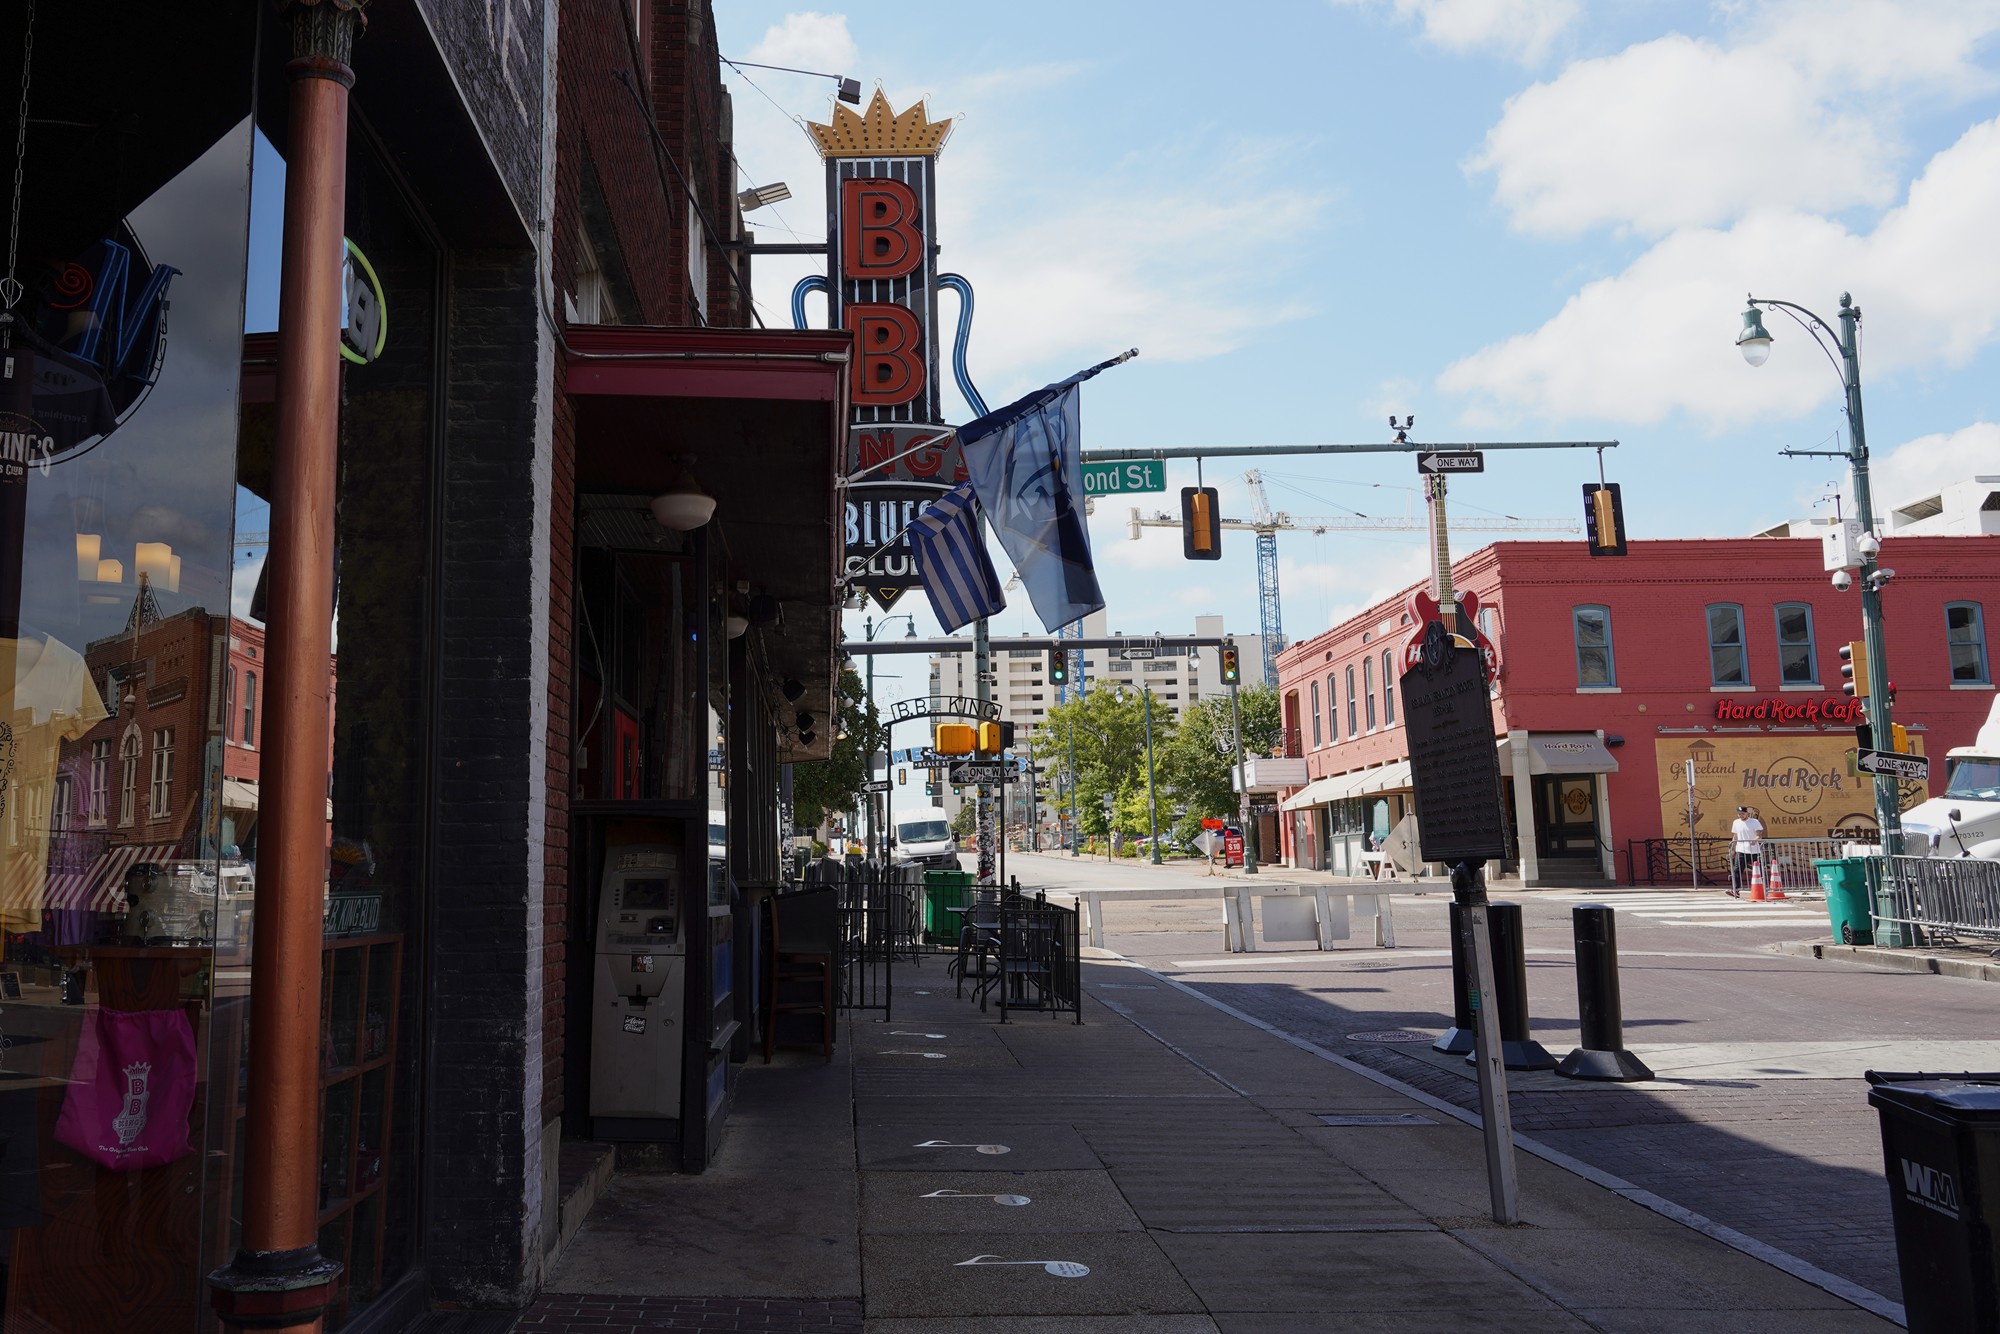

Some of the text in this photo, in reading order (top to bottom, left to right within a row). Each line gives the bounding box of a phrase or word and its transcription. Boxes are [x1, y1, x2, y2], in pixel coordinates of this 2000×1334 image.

[844, 178, 924, 280] B
[845, 302, 927, 407] B
[1437, 457, 1477, 467] ONE WAY
[1084, 465, 1157, 491] ond St.
[949, 697, 998, 718] KING
[1716, 698, 1768, 720] Hard
[1770, 698, 1819, 723] Rock
[1670, 762, 1737, 781] Grceland
[1877, 759, 1920, 772] ONE WAY
[1743, 767, 1843, 792] Hard Rock
[1783, 795, 1808, 803] CAFE
[1771, 815, 1823, 825] MEMPHIS
[1900, 1158, 1959, 1211] WM
